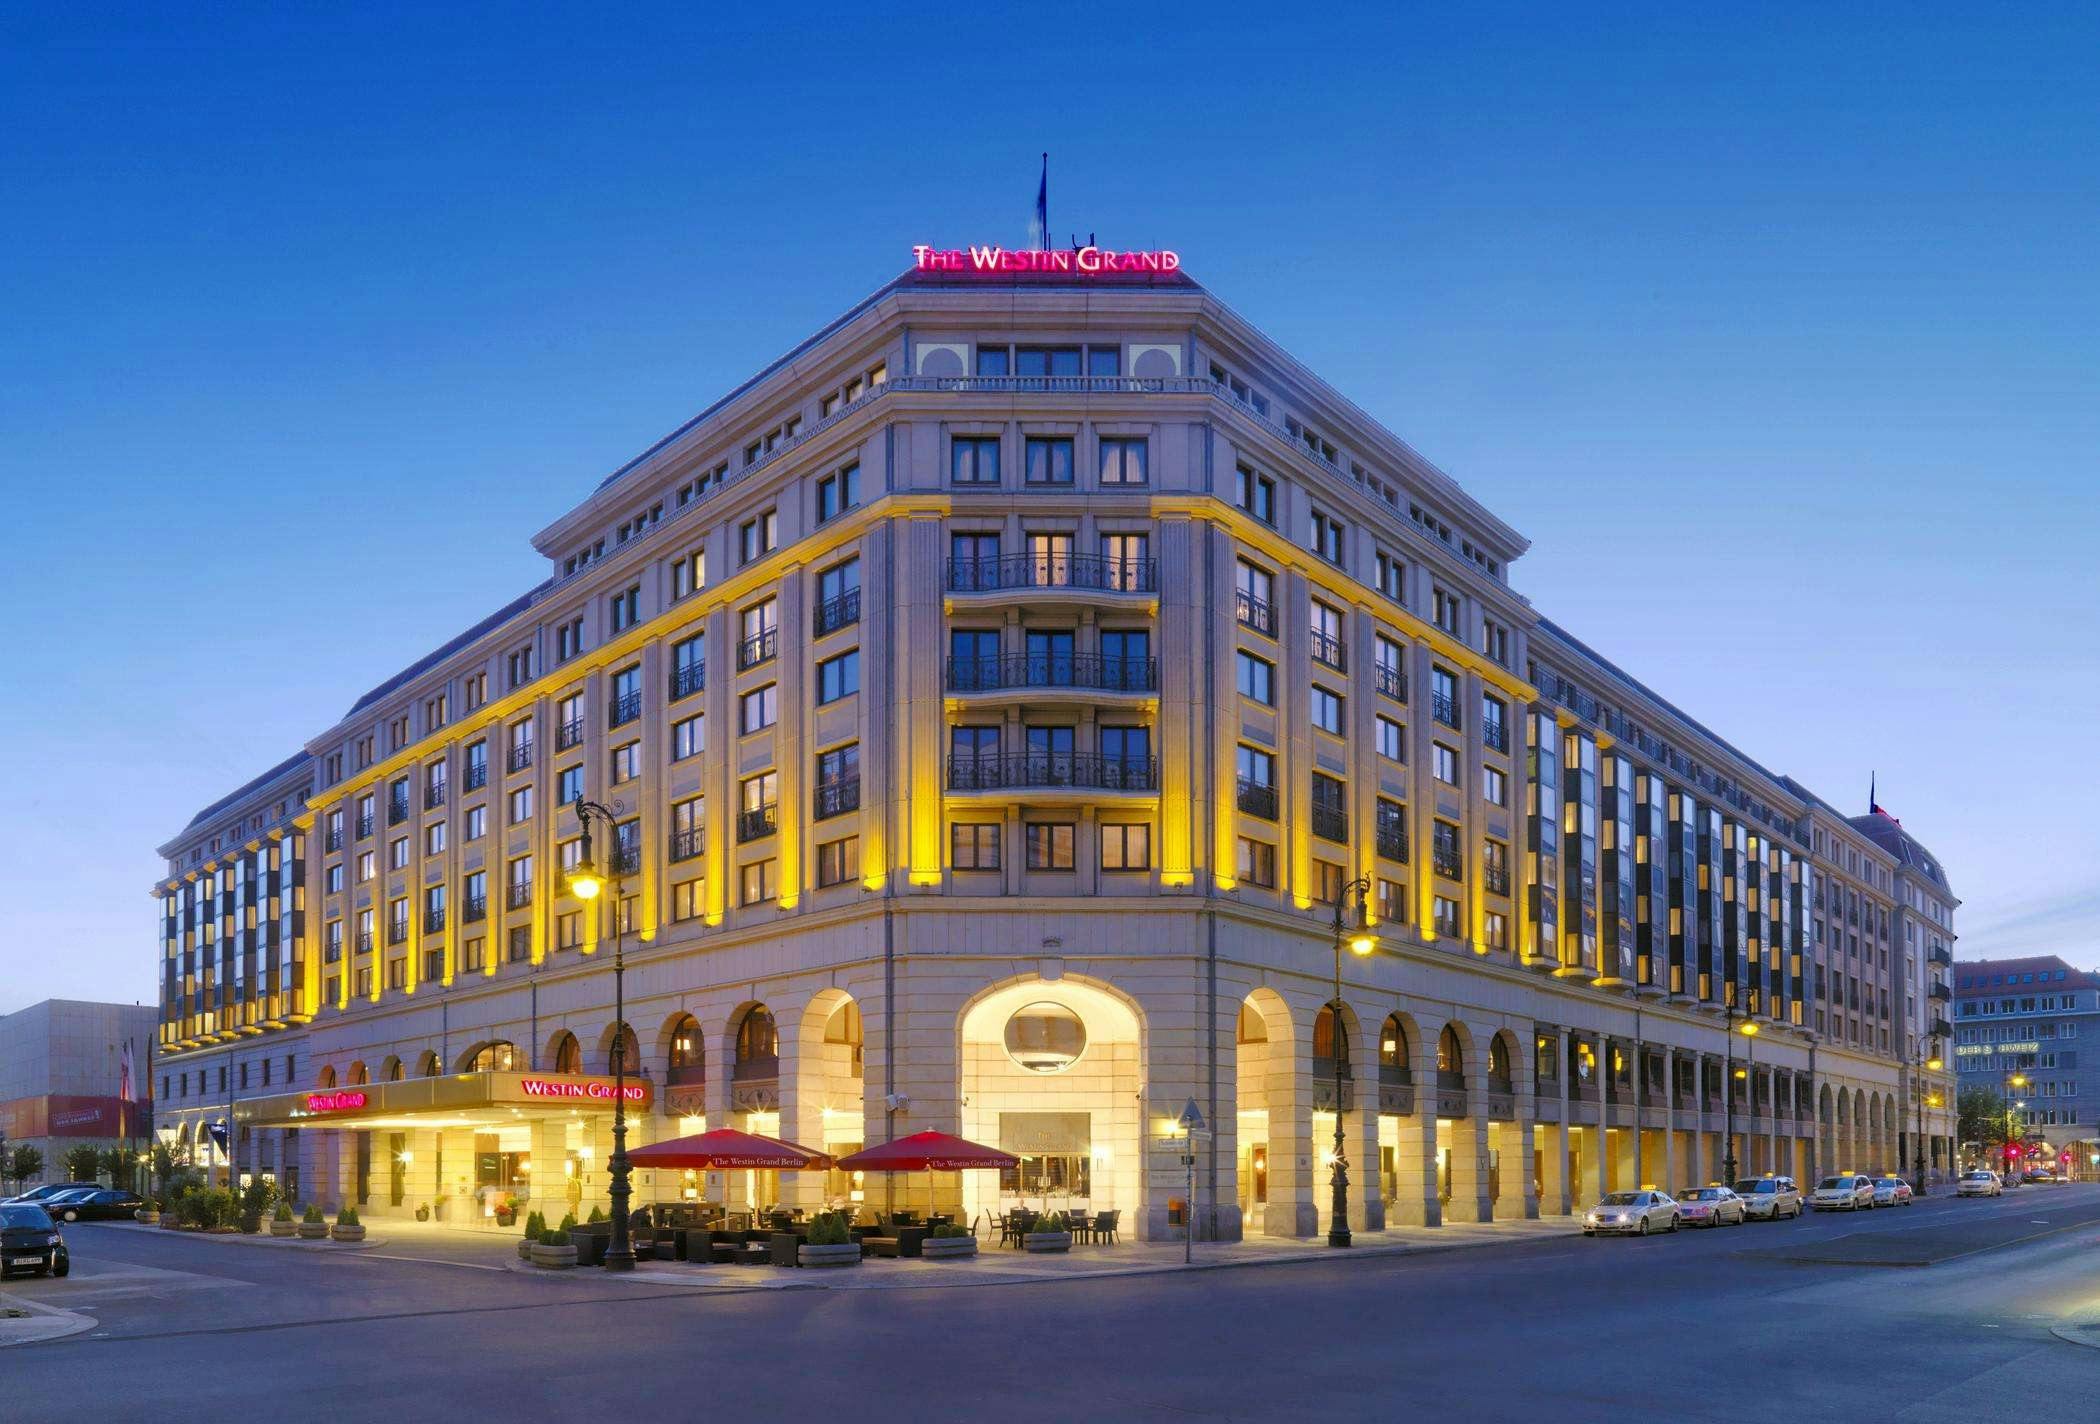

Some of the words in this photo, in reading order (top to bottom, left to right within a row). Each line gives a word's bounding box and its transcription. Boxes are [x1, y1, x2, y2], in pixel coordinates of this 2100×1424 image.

[913, 246, 963, 270] THE
[969, 247, 1069, 270] WESTIN
[1077, 247, 1180, 270] GRAND
[523, 1080, 583, 1096] WESTIN
[713, 1158, 729, 1166] The
[731, 1158, 756, 1166] Westin
[757, 1158, 780, 1166] Grand
[781, 1158, 804, 1167] Berlin
[931, 1160, 945, 1168] The
